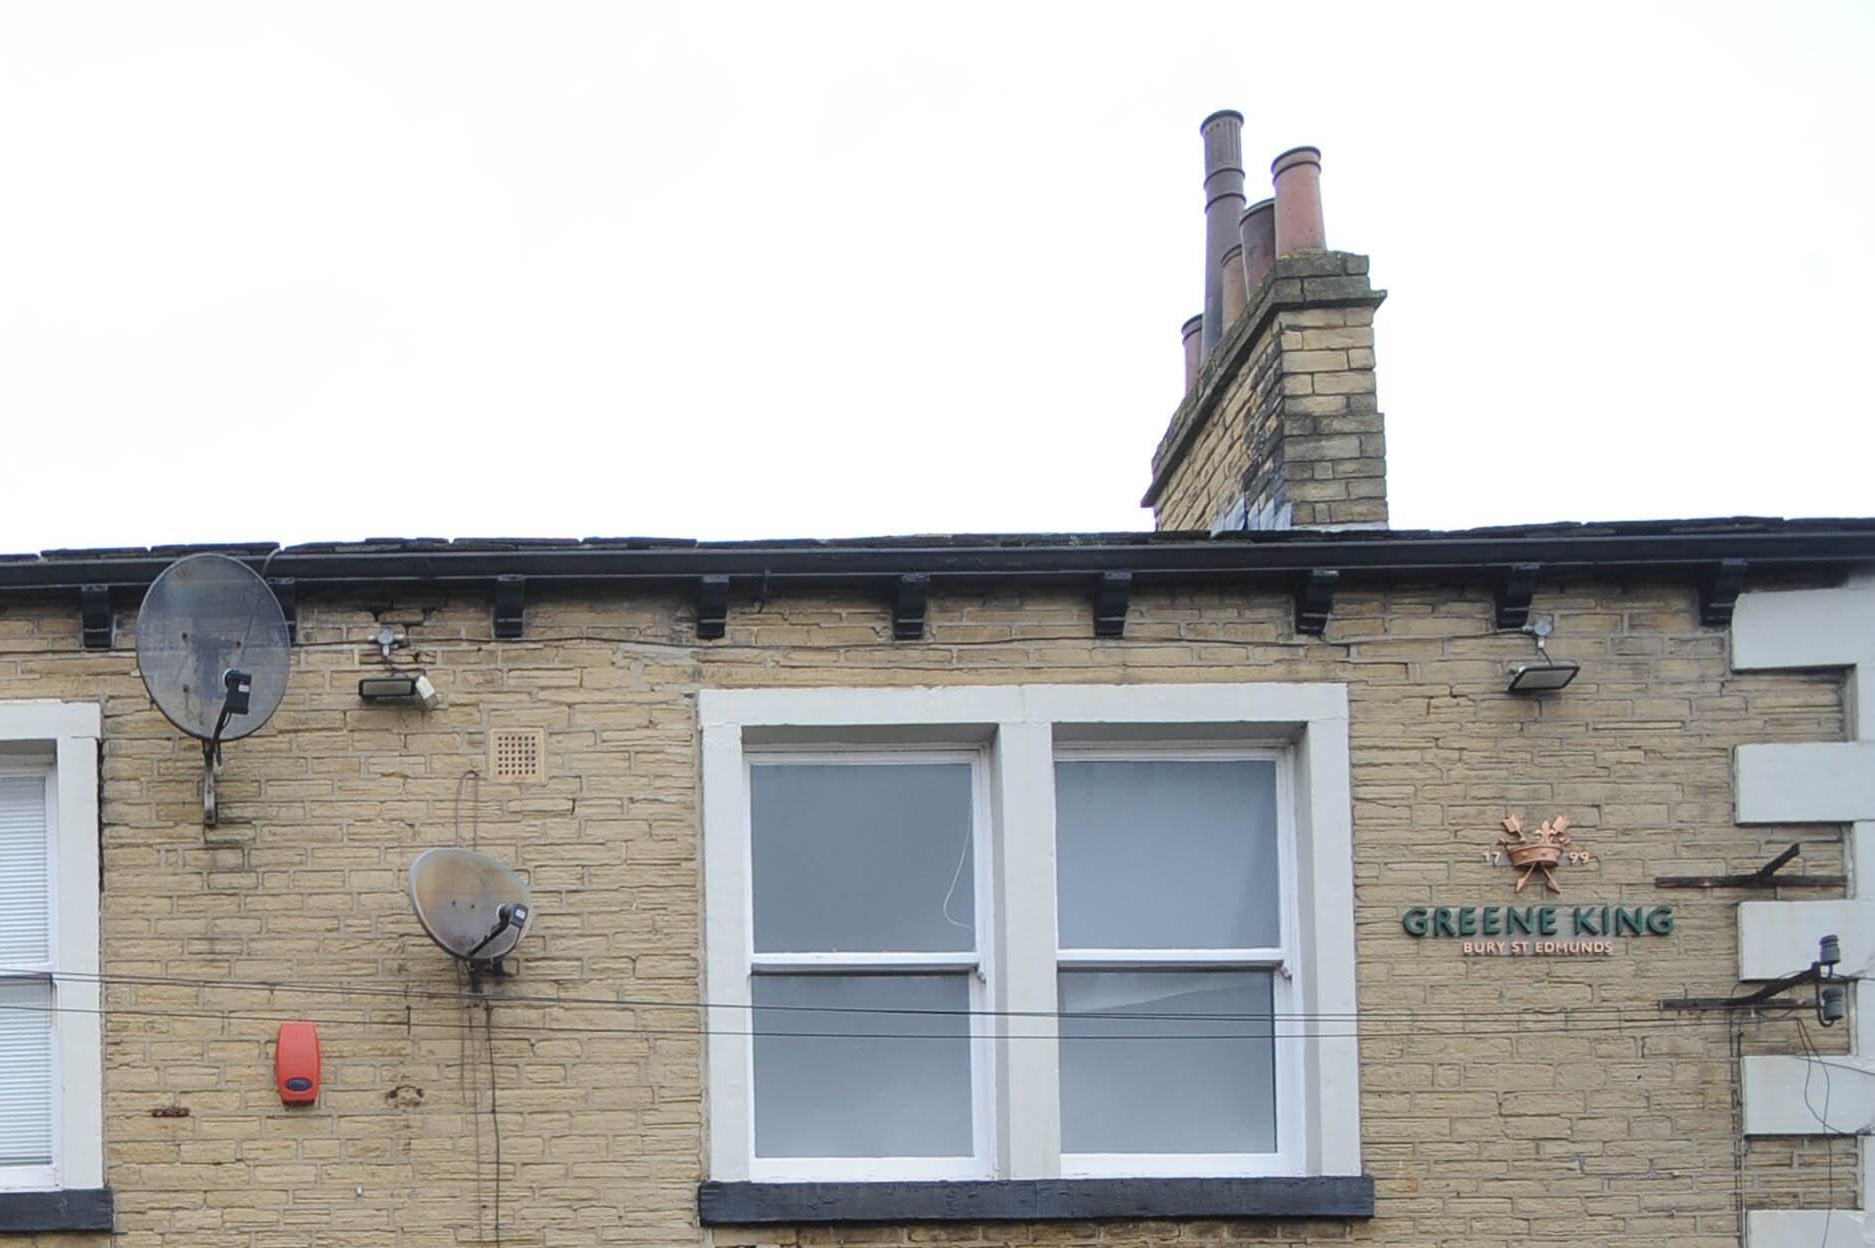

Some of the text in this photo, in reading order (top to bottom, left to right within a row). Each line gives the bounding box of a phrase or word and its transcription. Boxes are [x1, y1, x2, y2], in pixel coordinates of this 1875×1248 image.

[1402, 905, 1674, 937] GREENE KING
[1463, 941, 1613, 954] BURY ST EDMUNDS
